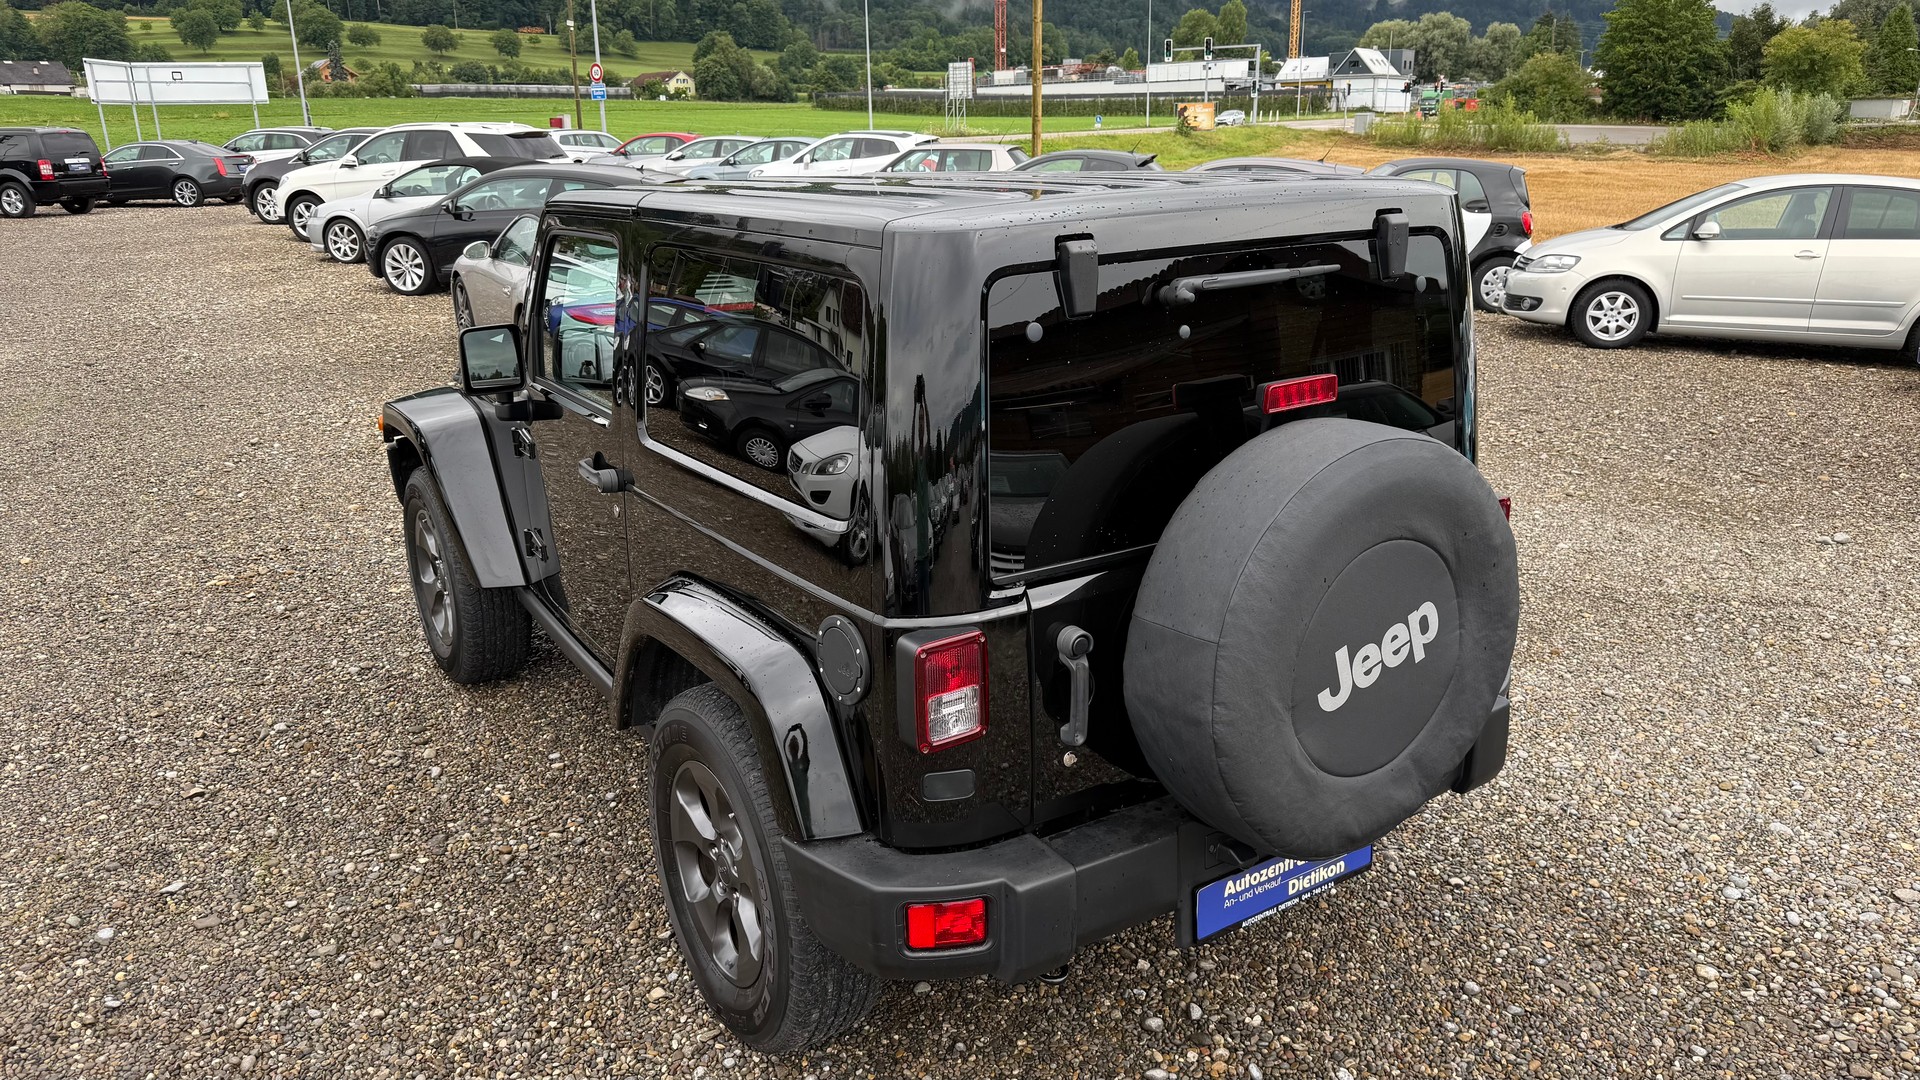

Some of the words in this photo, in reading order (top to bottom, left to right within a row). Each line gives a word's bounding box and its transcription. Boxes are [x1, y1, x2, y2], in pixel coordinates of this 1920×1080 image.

[1317, 601, 1439, 712] Jeep
[1224, 858, 1308, 898] Autozentr
[1224, 898, 1238, 909] An-
[1239, 888, 1254, 902] und
[1254, 876, 1281, 895] Verkauf
[1288, 860, 1345, 896] Dietikon
[1241, 907, 1277, 928] AUTOZENTRALE
[1278, 897, 1300, 911] DIETIKON
